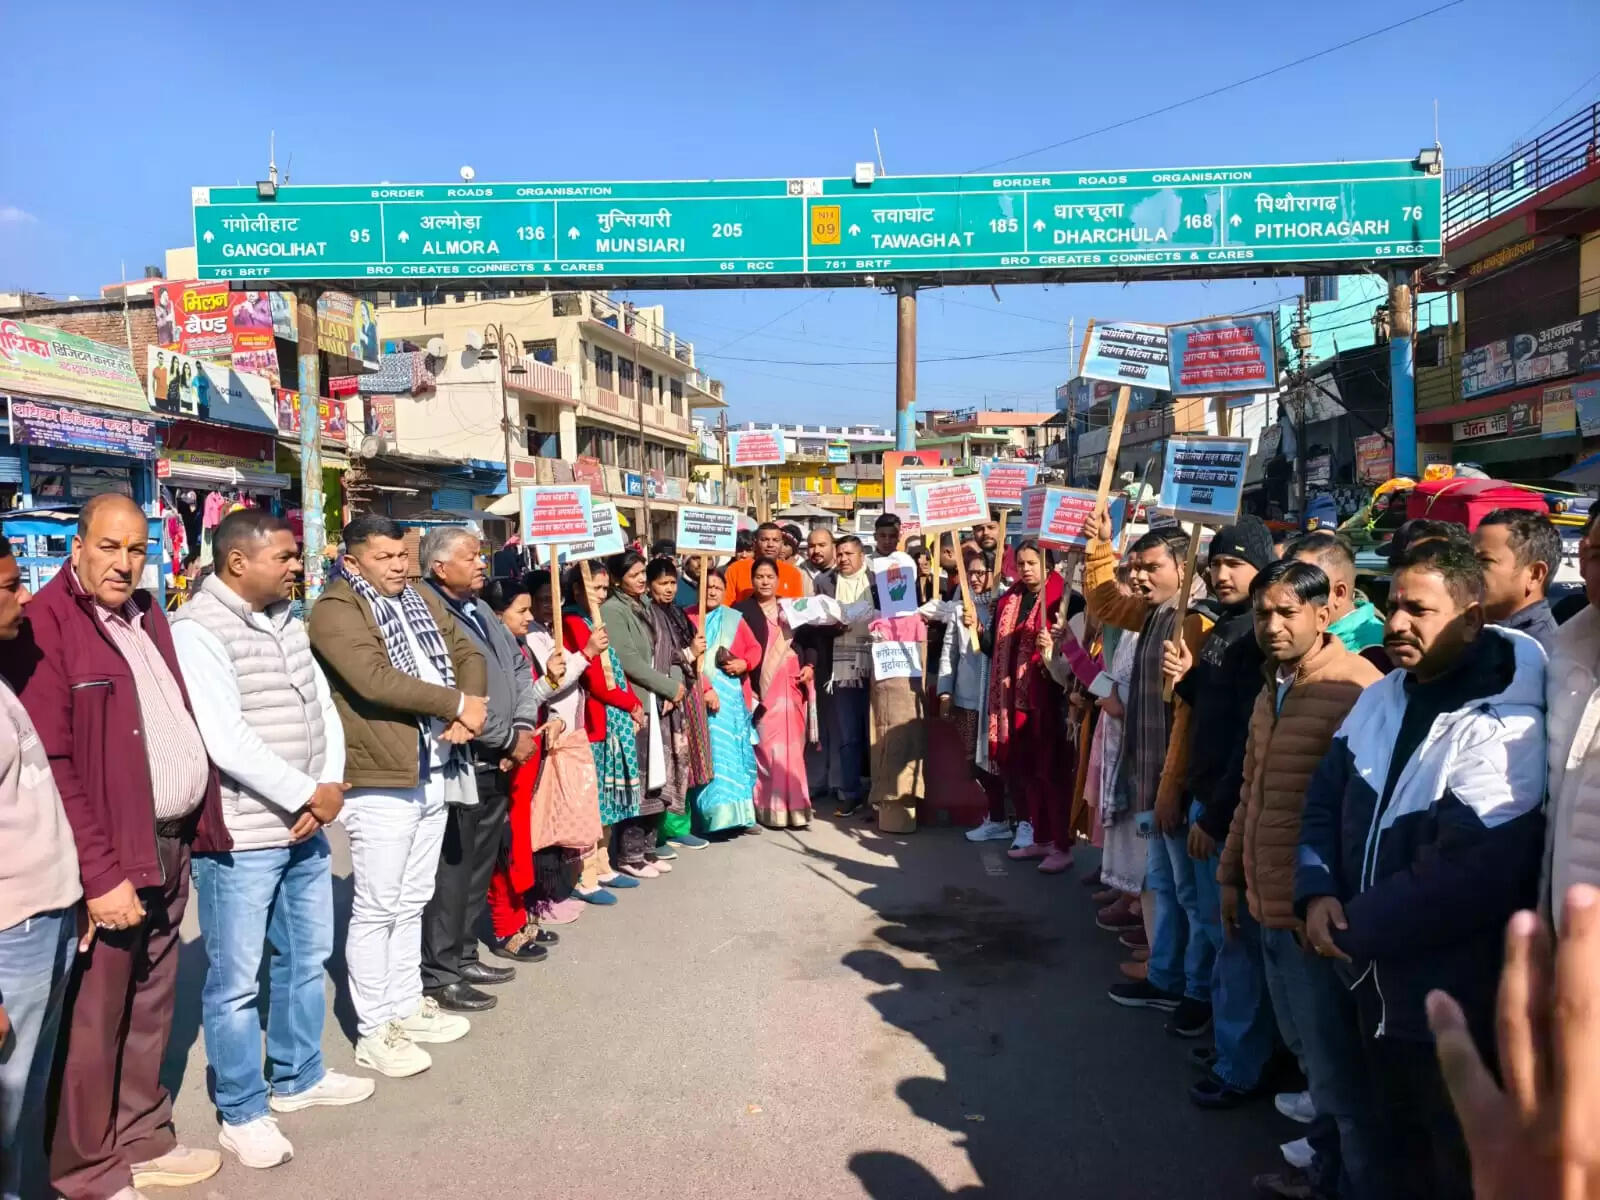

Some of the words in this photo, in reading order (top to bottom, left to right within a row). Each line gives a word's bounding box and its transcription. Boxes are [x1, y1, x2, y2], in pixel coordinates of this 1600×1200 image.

[993, 179, 1051, 188] BORDER
[1078, 175, 1128, 185] ROADS
[1152, 171, 1252, 183] ORGANISATION
[371, 189, 424, 198] BORDER
[447, 188, 493, 197] ROADS
[516, 186, 611, 196] ORGANISATION
[1254, 192, 1339, 214] पिथौरागढ़
[818, 211, 834, 219] NH
[871, 208, 935, 223] तवाघाट
[1054, 203, 1125, 222] धारचूला
[1402, 206, 1422, 221] 76
[221, 212, 300, 233] गंगोलीहाट
[420, 210, 482, 234] अल्मोड़ा
[596, 208, 672, 233] मुन्सियारी
[989, 218, 1018, 233] 185
[1184, 213, 1213, 229] 168
[350, 229, 370, 243] 95
[516, 227, 545, 240] 136
[712, 223, 742, 238] 205
[817, 223, 835, 235] 09
[1053, 227, 1168, 245] DHARCHULA
[1255, 219, 1390, 239] PITHORAGARH
[222, 242, 327, 257] GANGOLIHAT
[422, 240, 500, 255] ALMORA
[596, 238, 685, 252] MUNSIARI
[1375, 246, 1391, 254] 65
[1396, 245, 1424, 254] RCC
[825, 260, 847, 269] 761
[855, 260, 892, 269] BRTF
[1001, 256, 1030, 265] BRO
[1039, 254, 1101, 265] CREATES
[1109, 252, 1182, 263] CONNECTS
[1190, 251, 1199, 260] &
[1208, 250, 1254, 260] CARES
[214, 268, 233, 277] 761
[239, 268, 271, 277] BRTF
[366, 266, 394, 274] BRO
[402, 265, 460, 274] CREATES
[468, 264, 535, 273] CONNECTS
[543, 263, 552, 271] &
[561, 263, 604, 271] CARES
[720, 262, 735, 270] 65
[747, 261, 774, 270] RCC
[183, 289, 229, 313] मिलन
[184, 314, 228, 334] बैण्ड
[319, 318, 349, 341] LAN
[1539, 320, 1583, 342] आनन्द
[52, 341, 92, 362] डिजिटल
